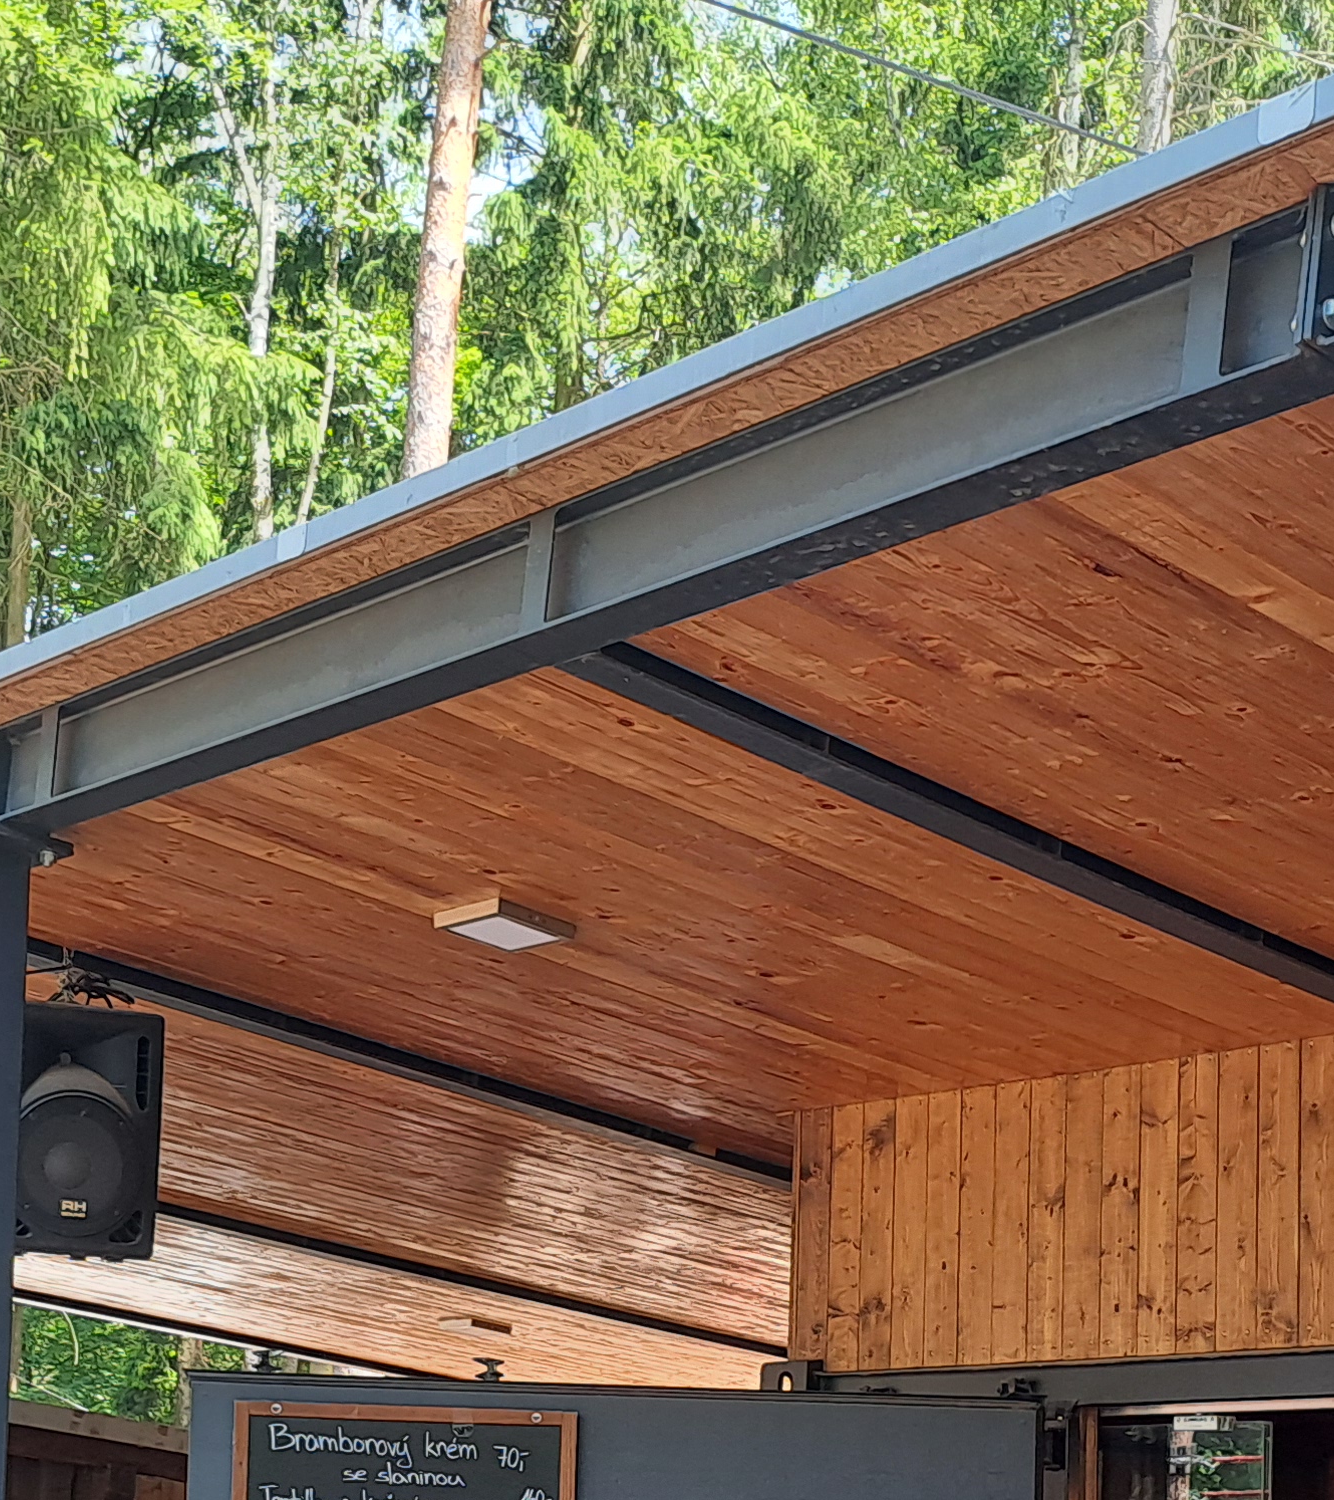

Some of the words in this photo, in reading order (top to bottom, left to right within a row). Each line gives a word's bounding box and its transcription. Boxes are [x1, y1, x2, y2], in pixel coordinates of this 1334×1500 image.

[268, 1423, 413, 1468] Bramborový
[425, 1431, 478, 1461] krém
[342, 1468, 367, 1482] se
[375, 1462, 466, 1488] slaninou
